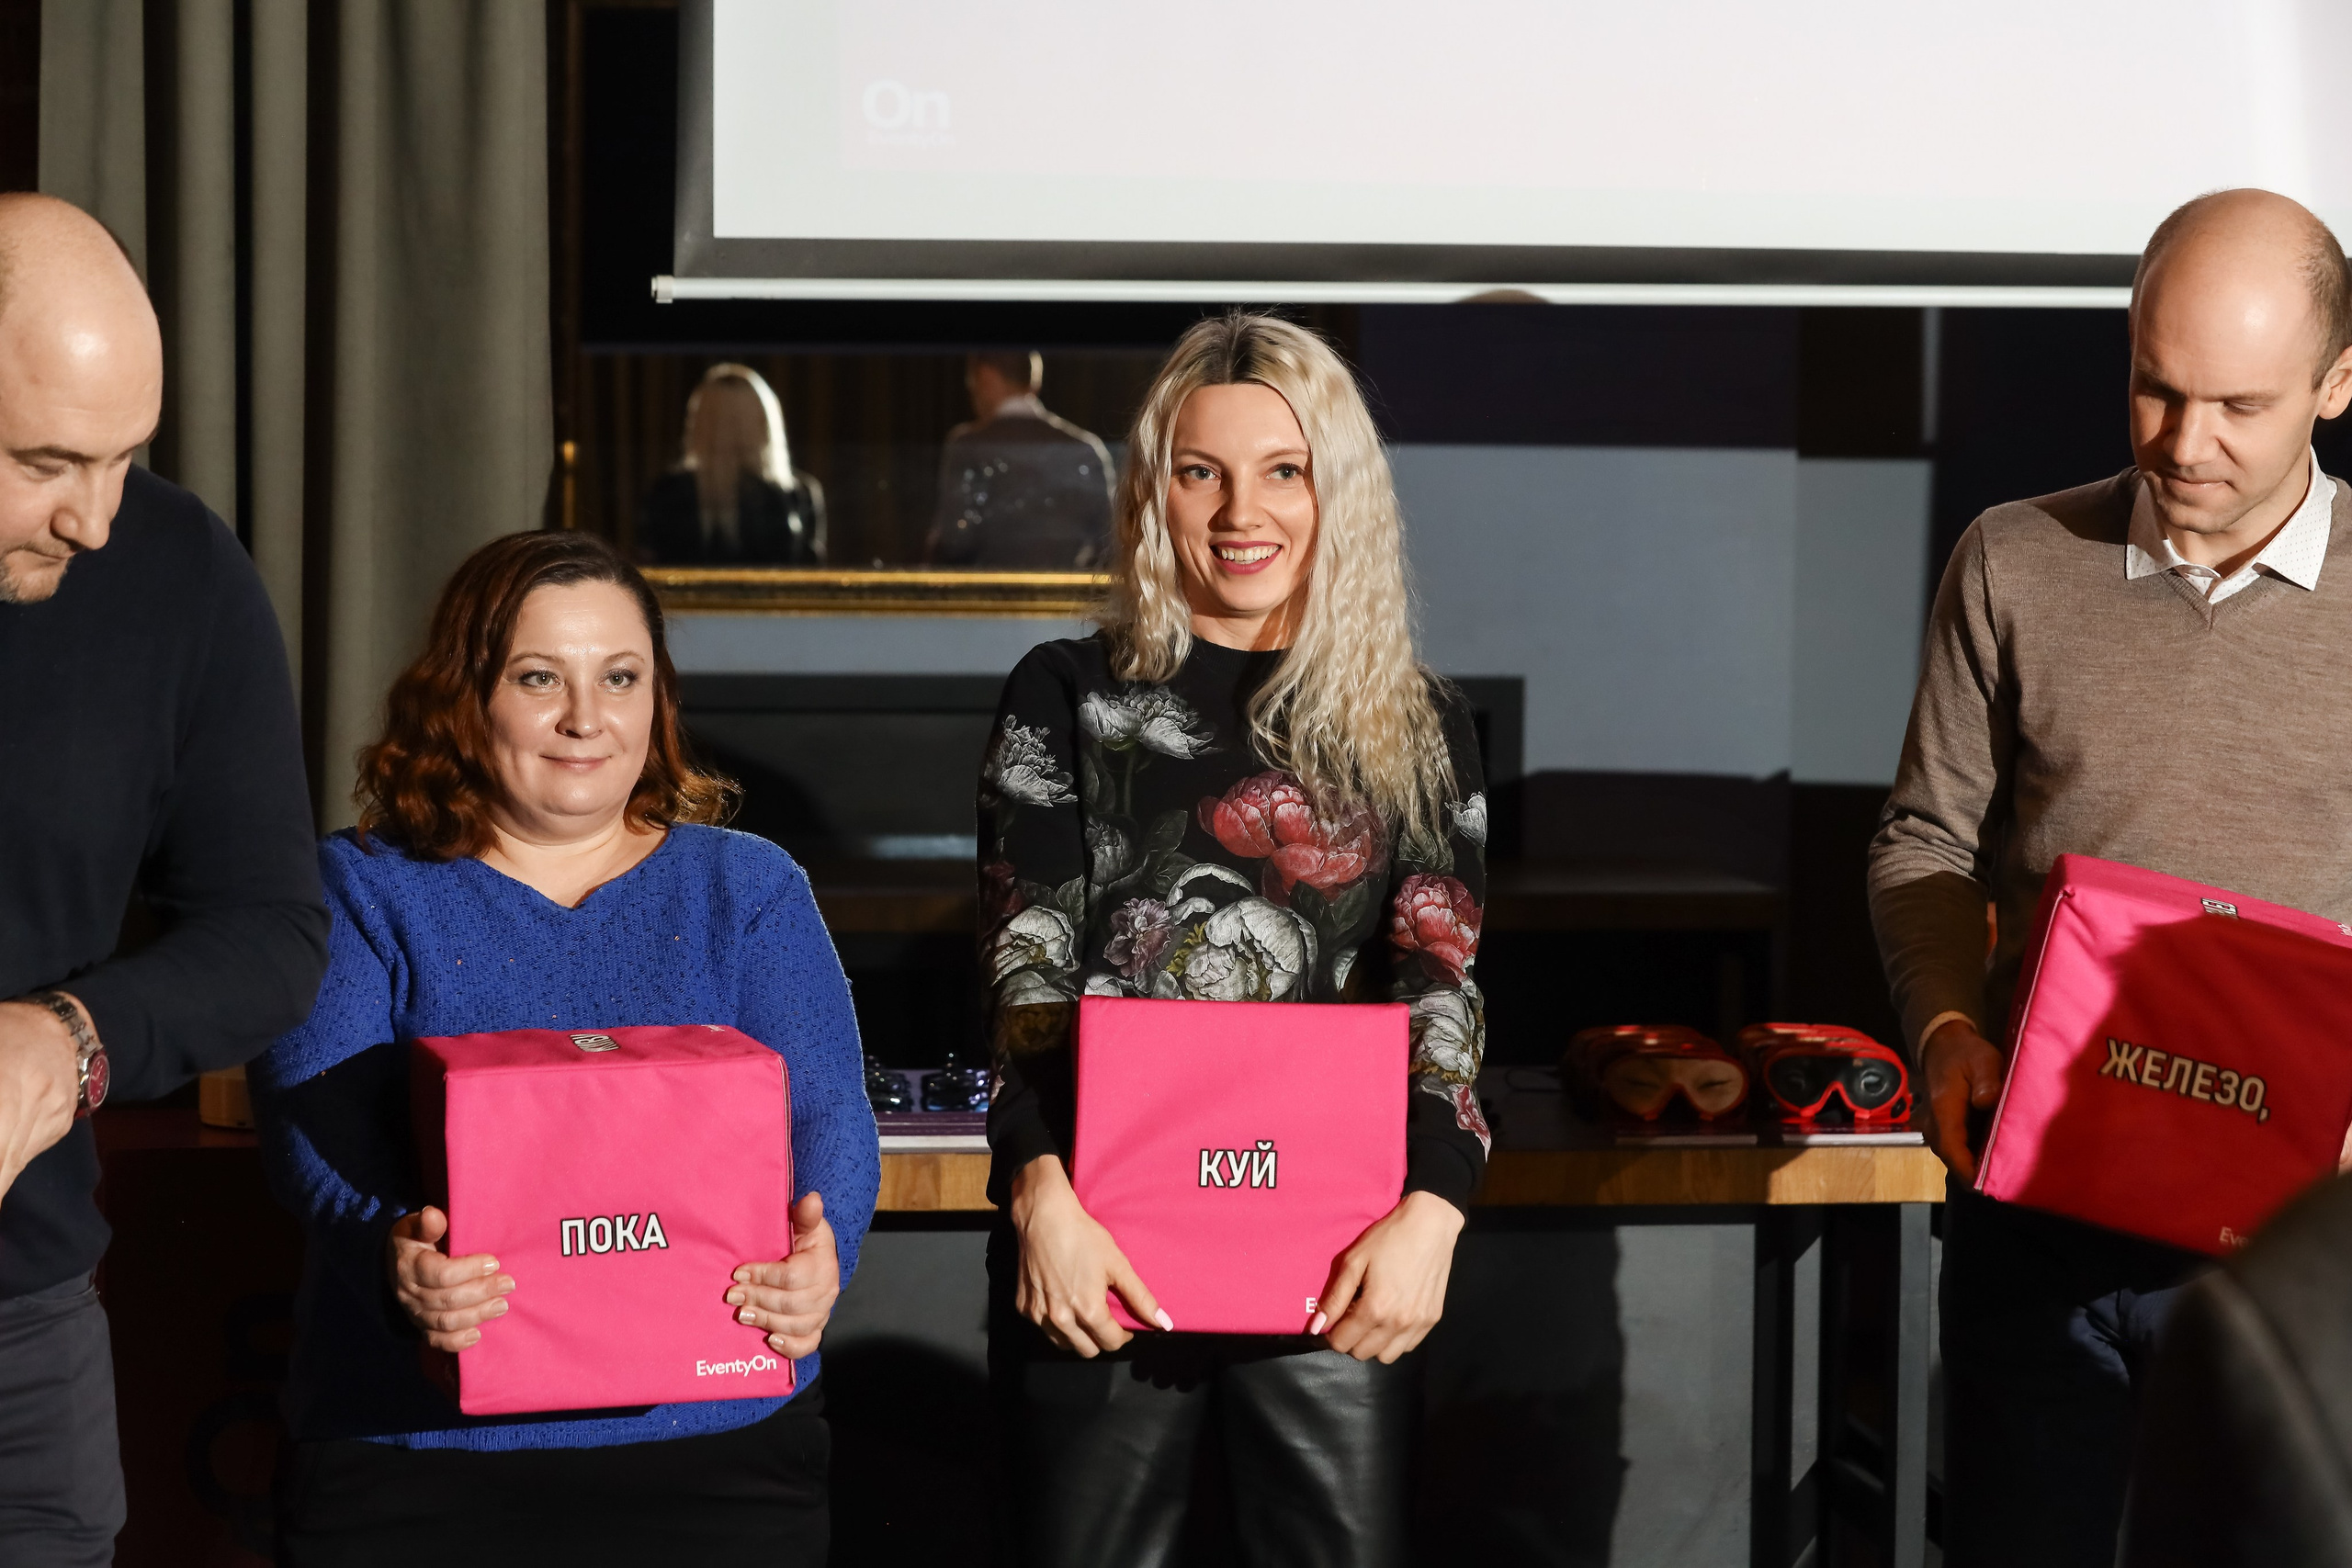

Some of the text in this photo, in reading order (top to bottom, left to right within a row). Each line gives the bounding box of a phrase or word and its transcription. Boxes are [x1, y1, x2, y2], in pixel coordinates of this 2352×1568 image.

[862, 79, 951, 128] On
[2098, 1037, 2270, 1124] ЖЕЛЕЗО,
[1199, 1140, 1278, 1189] КУЙ
[560, 1213, 669, 1257] ПОКА
[2219, 1225, 2249, 1248] Eve
[695, 1354, 777, 1377] EventyOn
